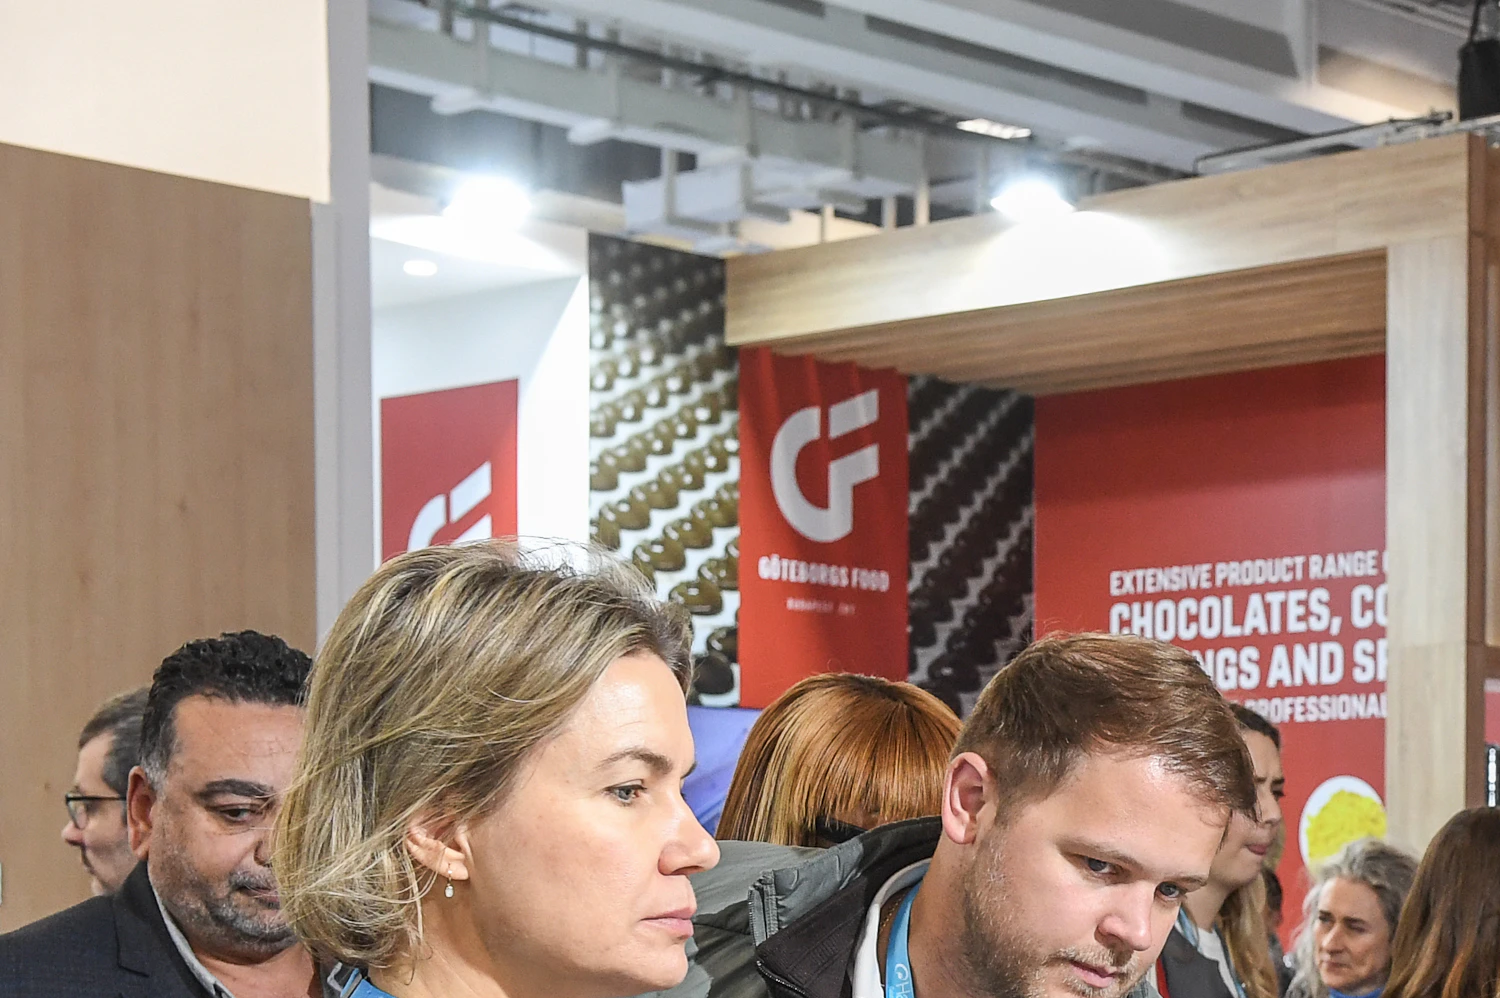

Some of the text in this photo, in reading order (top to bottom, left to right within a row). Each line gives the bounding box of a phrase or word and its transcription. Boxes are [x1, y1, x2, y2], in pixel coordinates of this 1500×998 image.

[851, 566, 890, 593] FOOD
[1109, 549, 1379, 597] EXTENSIVE PRODUCT RANGE
[1266, 641, 1345, 688] AND
